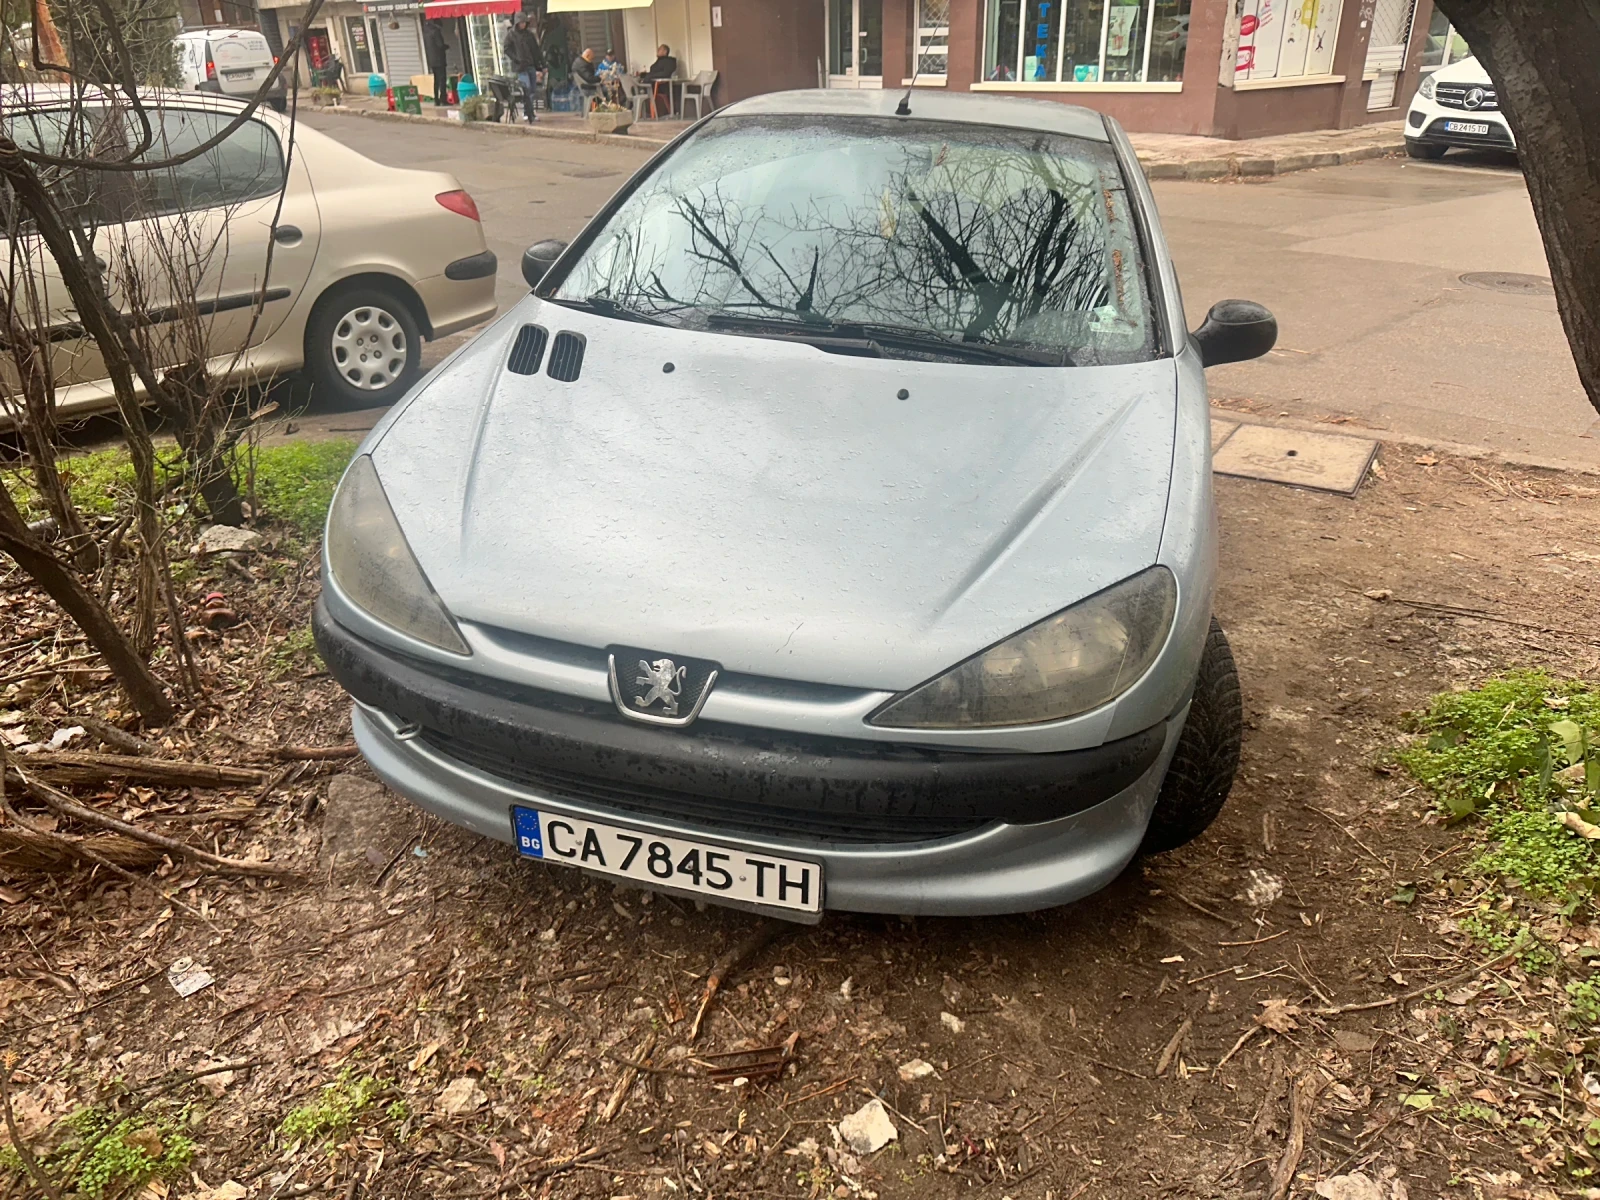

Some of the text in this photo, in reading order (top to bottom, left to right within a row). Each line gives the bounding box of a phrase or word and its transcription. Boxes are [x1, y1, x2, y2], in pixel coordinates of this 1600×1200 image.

[1450, 123, 1458, 131] CB
[1459, 124, 1476, 132] 2415
[521, 836, 540, 850] BG
[547, 820, 810, 905] CA 7845 TH
